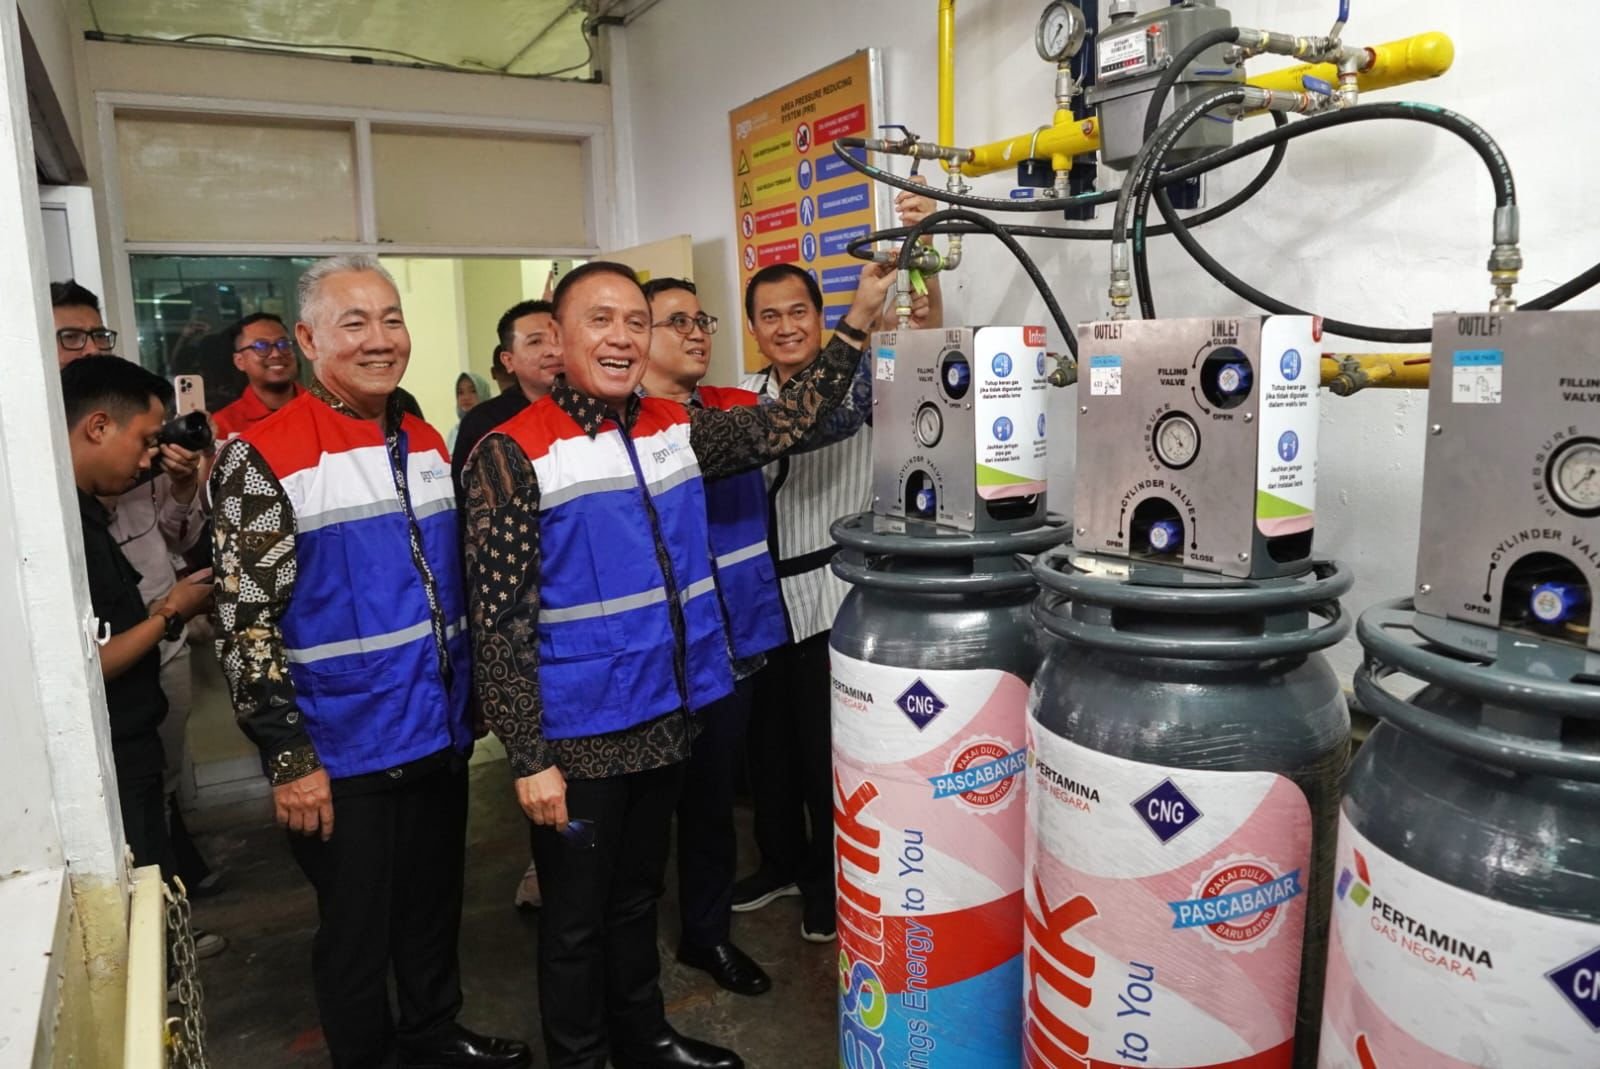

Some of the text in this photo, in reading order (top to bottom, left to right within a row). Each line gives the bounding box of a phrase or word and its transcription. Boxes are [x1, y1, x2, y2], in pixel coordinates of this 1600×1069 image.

[1094, 324, 1123, 340] OUTLET
[1212, 320, 1239, 337] INLET
[1213, 338, 1238, 346] CLOSE
[1158, 368, 1188, 376] FILLING
[1160, 378, 1186, 386] VALVE
[1532, 425, 1579, 517] PRESSURE
[1121, 479, 1196, 515] CYLINDER VALVE
[1106, 540, 1124, 548] OPEN
[1490, 528, 1562, 562] CYLINDER
[1190, 553, 1214, 563] CLOSE
[1464, 602, 1491, 615] OPEN
[832, 676, 874, 704] PERTAMINA
[906, 694, 934, 714] CNG
[957, 746, 1003, 769] PAKAI DULU
[937, 752, 1026, 795] PASCABAYAR
[1036, 758, 1100, 803] PERTAMINA
[966, 780, 1010, 804] BARU BAYAR
[1050, 784, 1091, 814] NEGARA
[1148, 798, 1185, 824] CNG
[899, 829, 924, 877] You
[1208, 868, 1267, 896] PAKAI DULU
[901, 887, 925, 912] to
[1179, 878, 1296, 924] PASCABAYAR
[1216, 912, 1273, 939] BARU BAYAR
[1372, 895, 1494, 970] PERTAMINA
[1370, 916, 1477, 982] GAS NEGARA
[902, 918, 934, 1012] Energy
[1116, 961, 1154, 1063] to You
